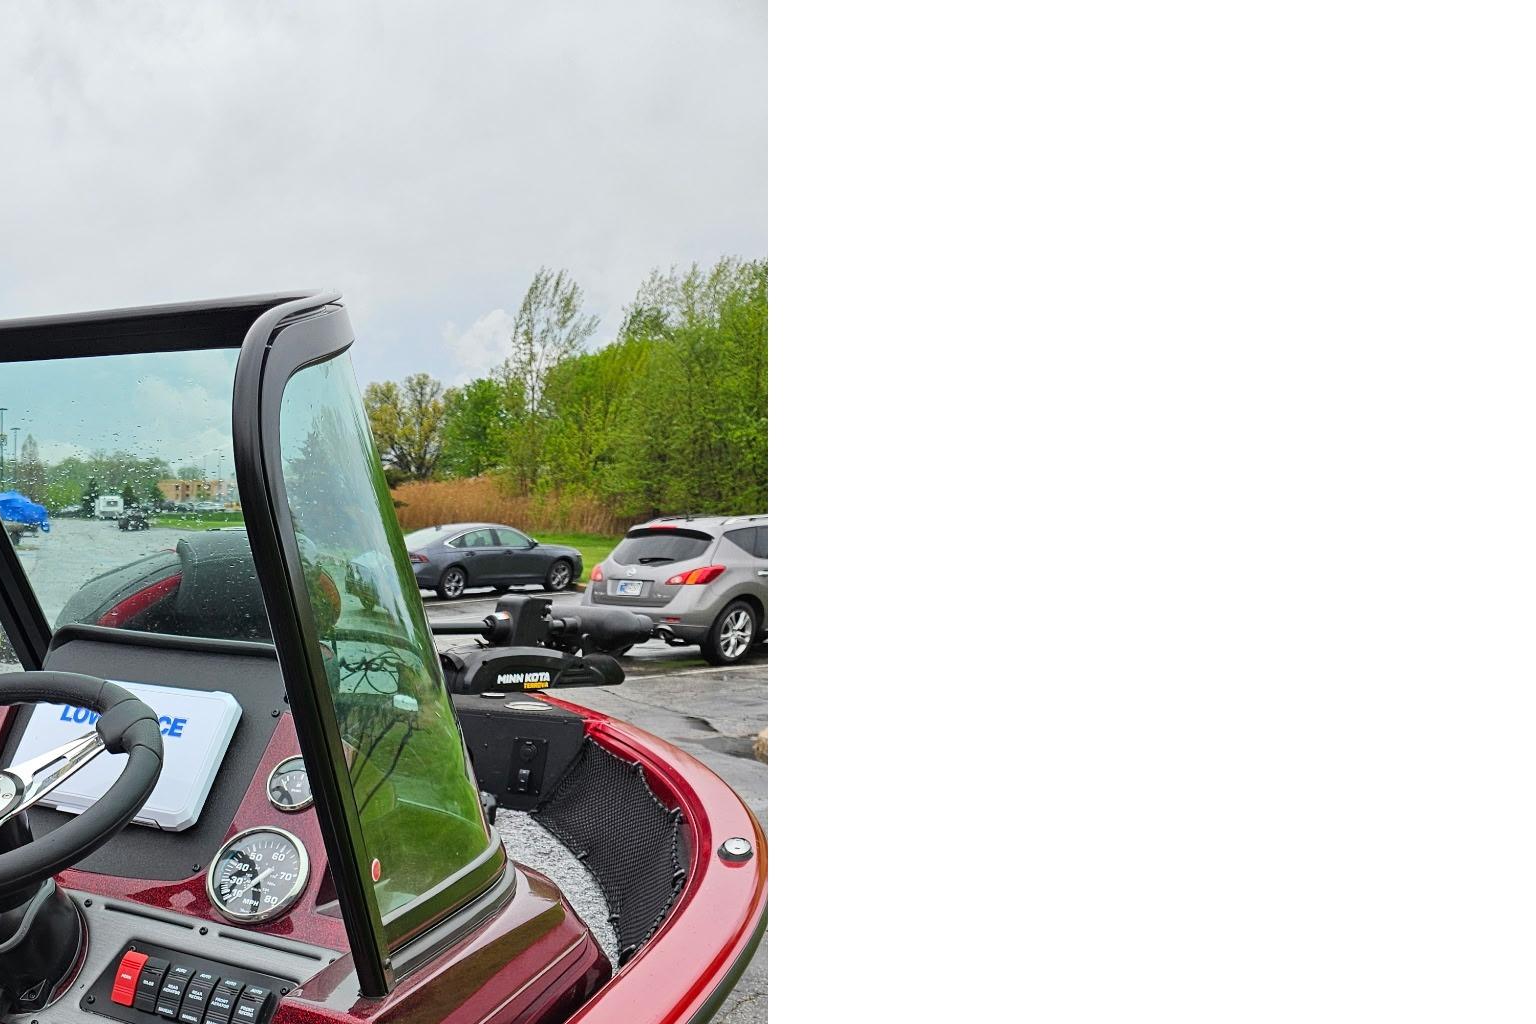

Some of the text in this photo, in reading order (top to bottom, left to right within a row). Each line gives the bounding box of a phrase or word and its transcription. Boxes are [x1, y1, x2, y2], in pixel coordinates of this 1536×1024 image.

[497, 672, 550, 684] MINN KOTA
[249, 852, 263, 861] 50
[272, 852, 285, 861] 60
[235, 863, 250, 872] 40
[230, 876, 244, 885] 30
[279, 872, 292, 881] 70
[242, 898, 260, 907] MPH
[263, 895, 278, 904] 80
